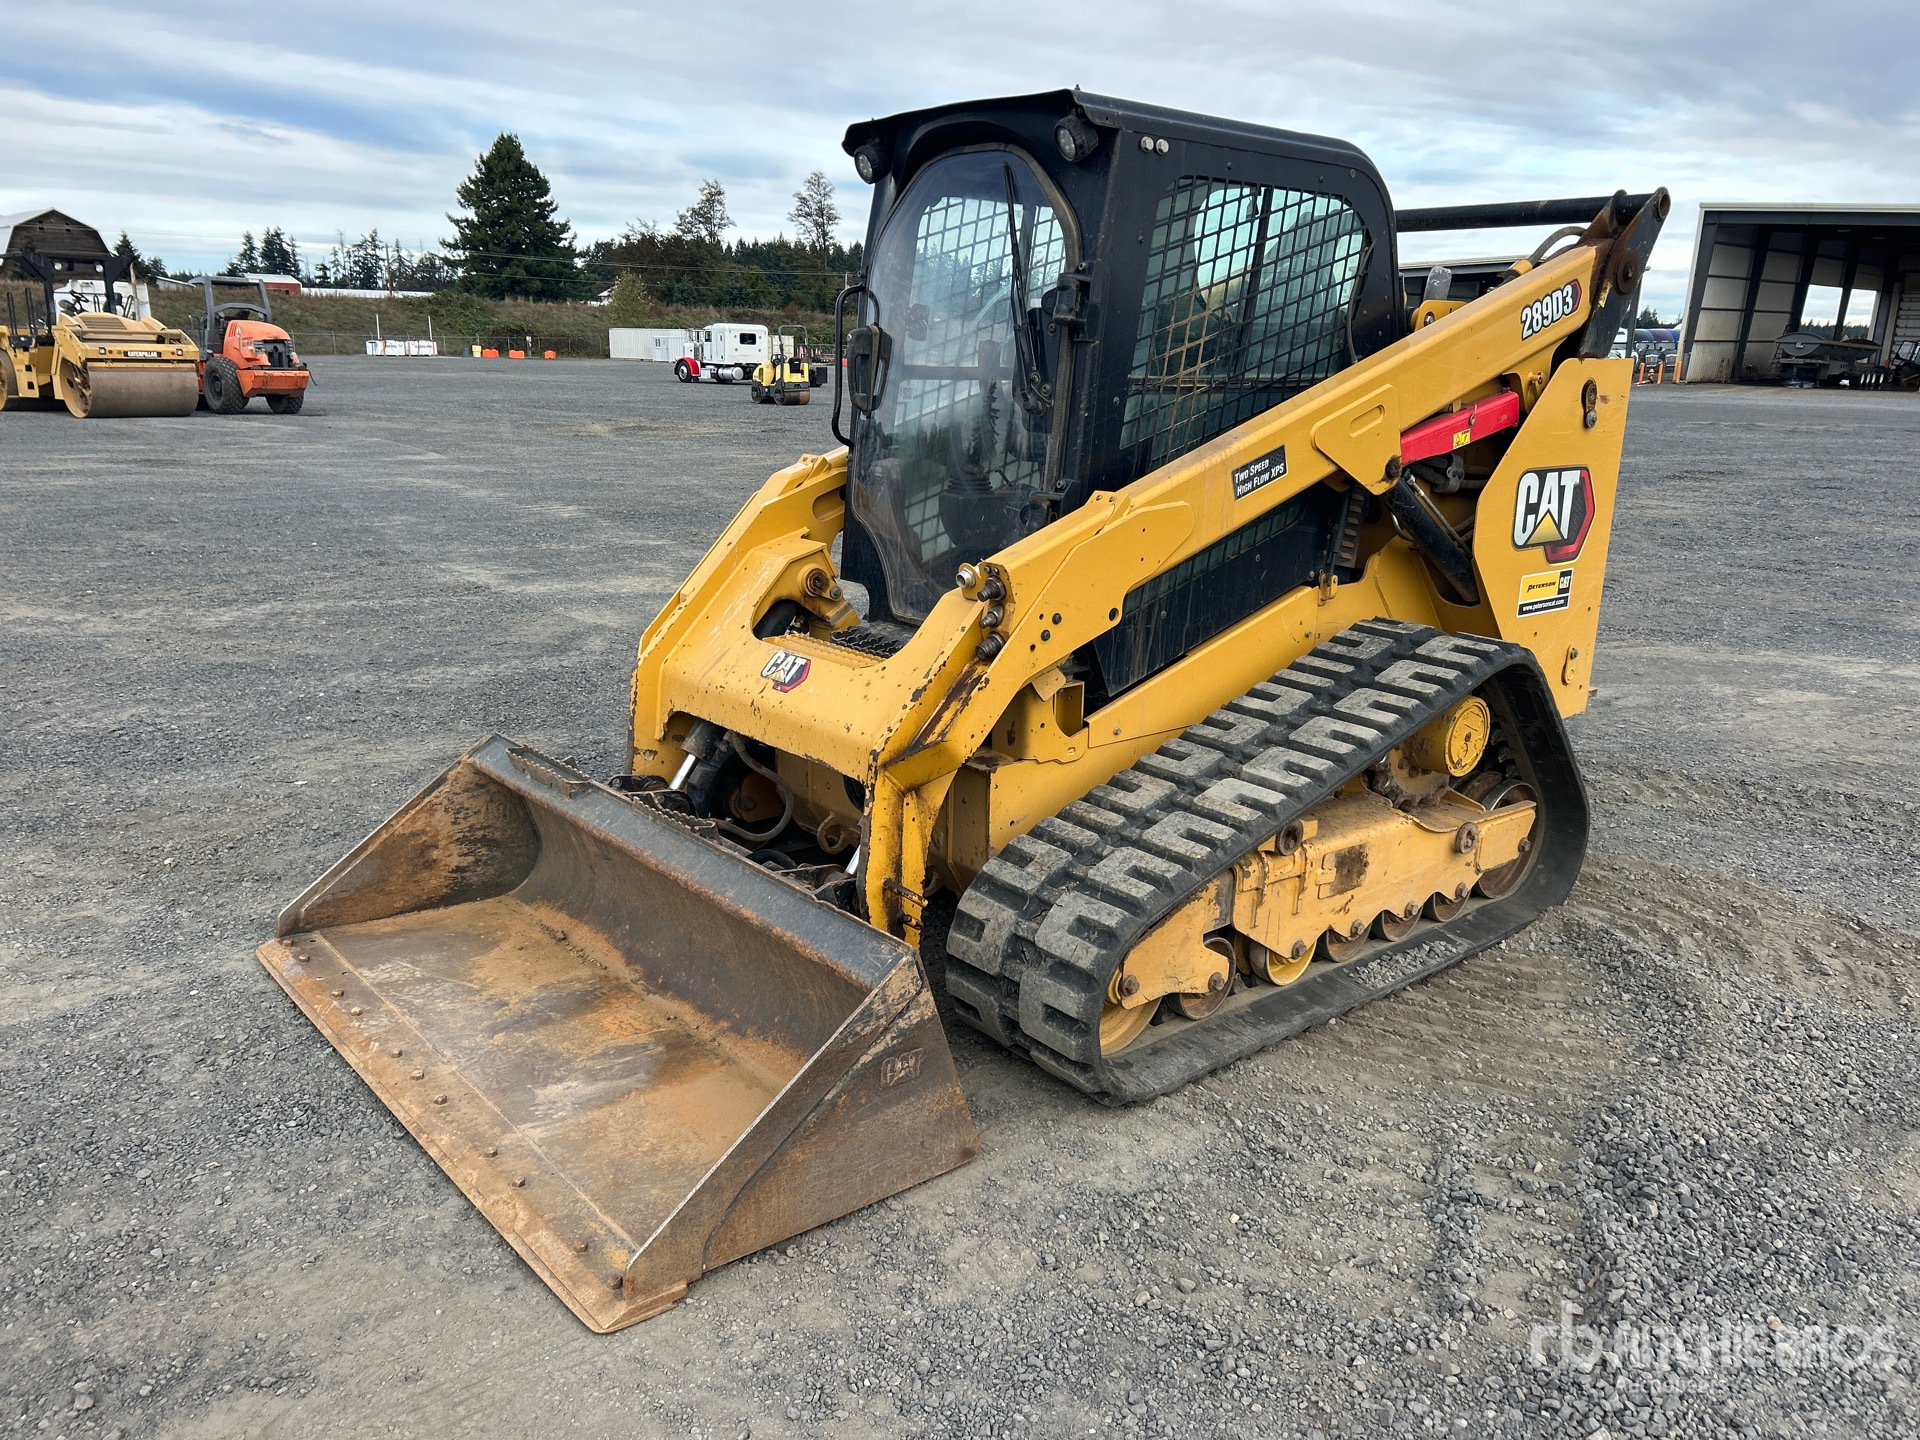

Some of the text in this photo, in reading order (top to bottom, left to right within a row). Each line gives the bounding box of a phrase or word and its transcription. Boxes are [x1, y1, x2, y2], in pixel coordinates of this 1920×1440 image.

[1521, 284, 1573, 339] 289D3
[127, 350, 158, 358] CATERPILLAR
[1270, 463, 1285, 479] XPS
[1513, 470, 1581, 546] CAT
[761, 650, 808, 684] CAT
